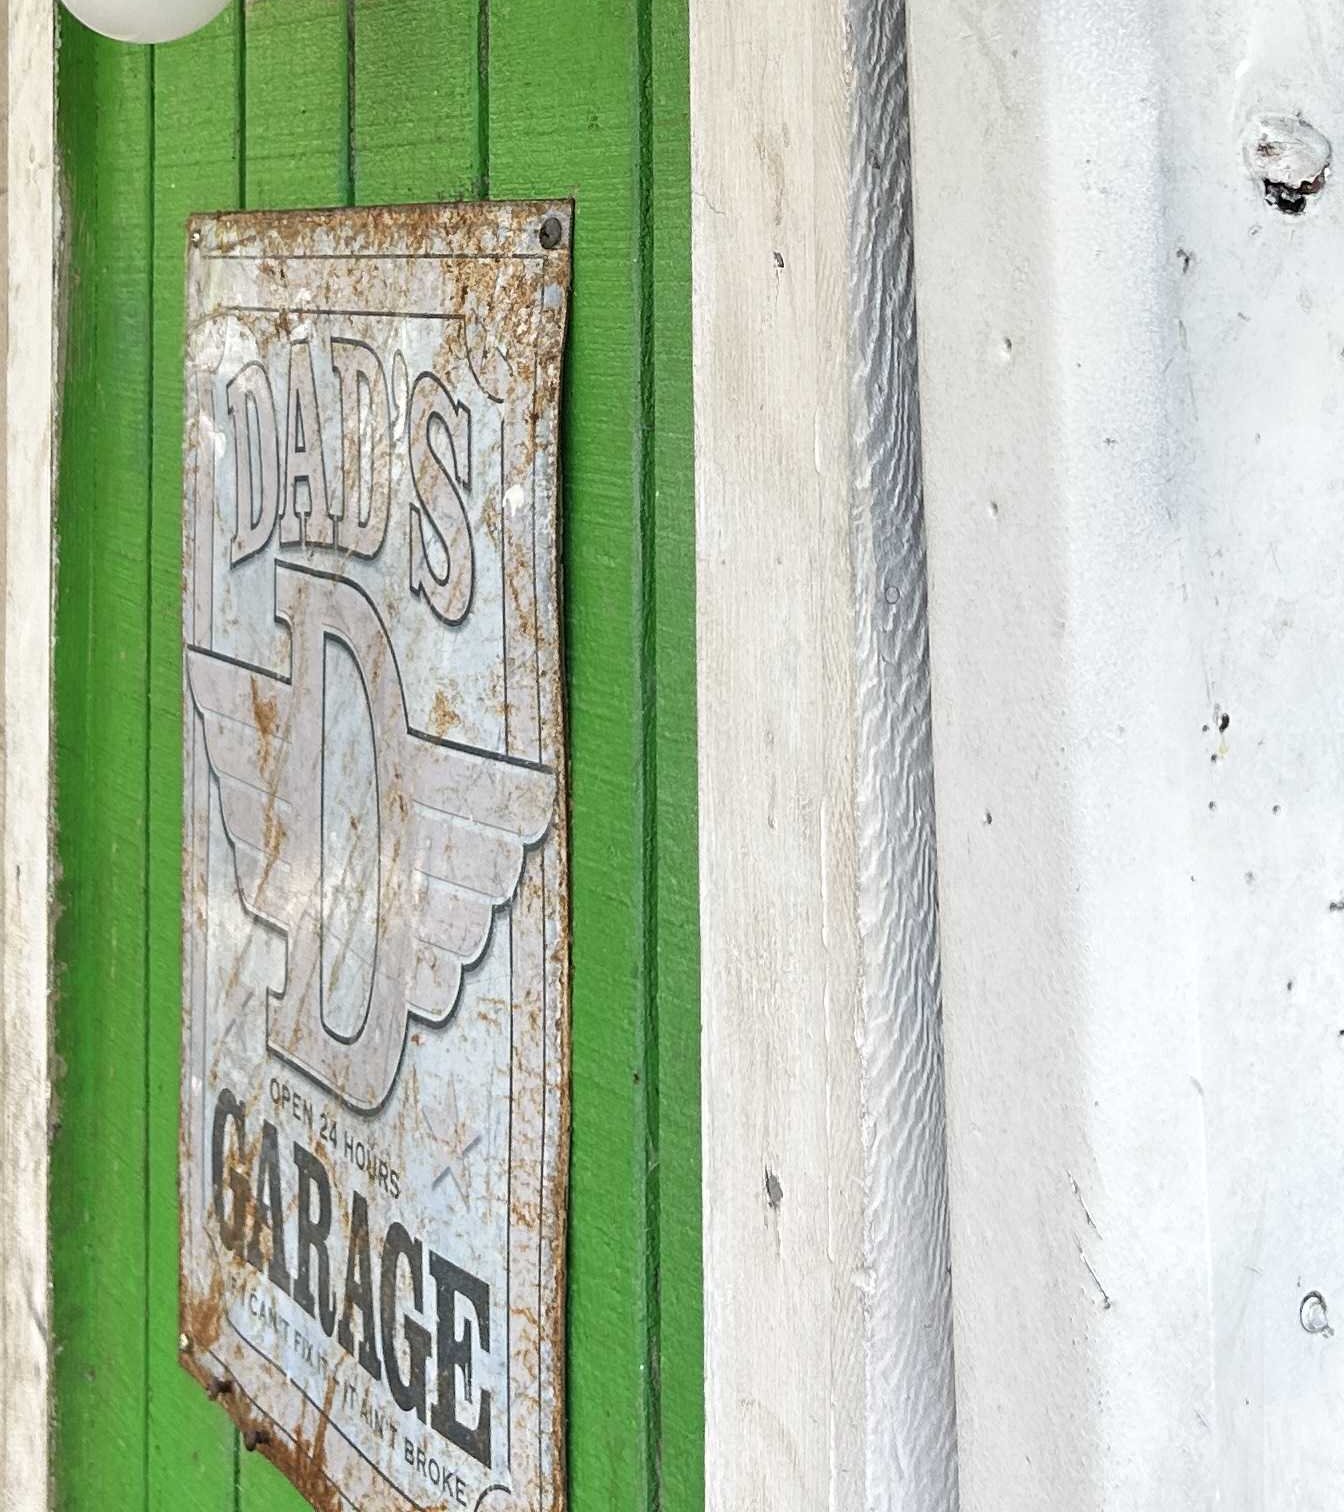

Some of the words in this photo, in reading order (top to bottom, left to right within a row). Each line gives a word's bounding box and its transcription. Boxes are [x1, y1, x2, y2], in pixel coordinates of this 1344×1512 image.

[226, 336, 475, 626] DAD'S
[270, 1078, 313, 1132] OPEN
[319, 1112, 337, 1149] 24
[343, 1130, 401, 1200] HOURS
[210, 1088, 492, 1471] GARAGE
[404, 1438, 467, 1507] BROKE
